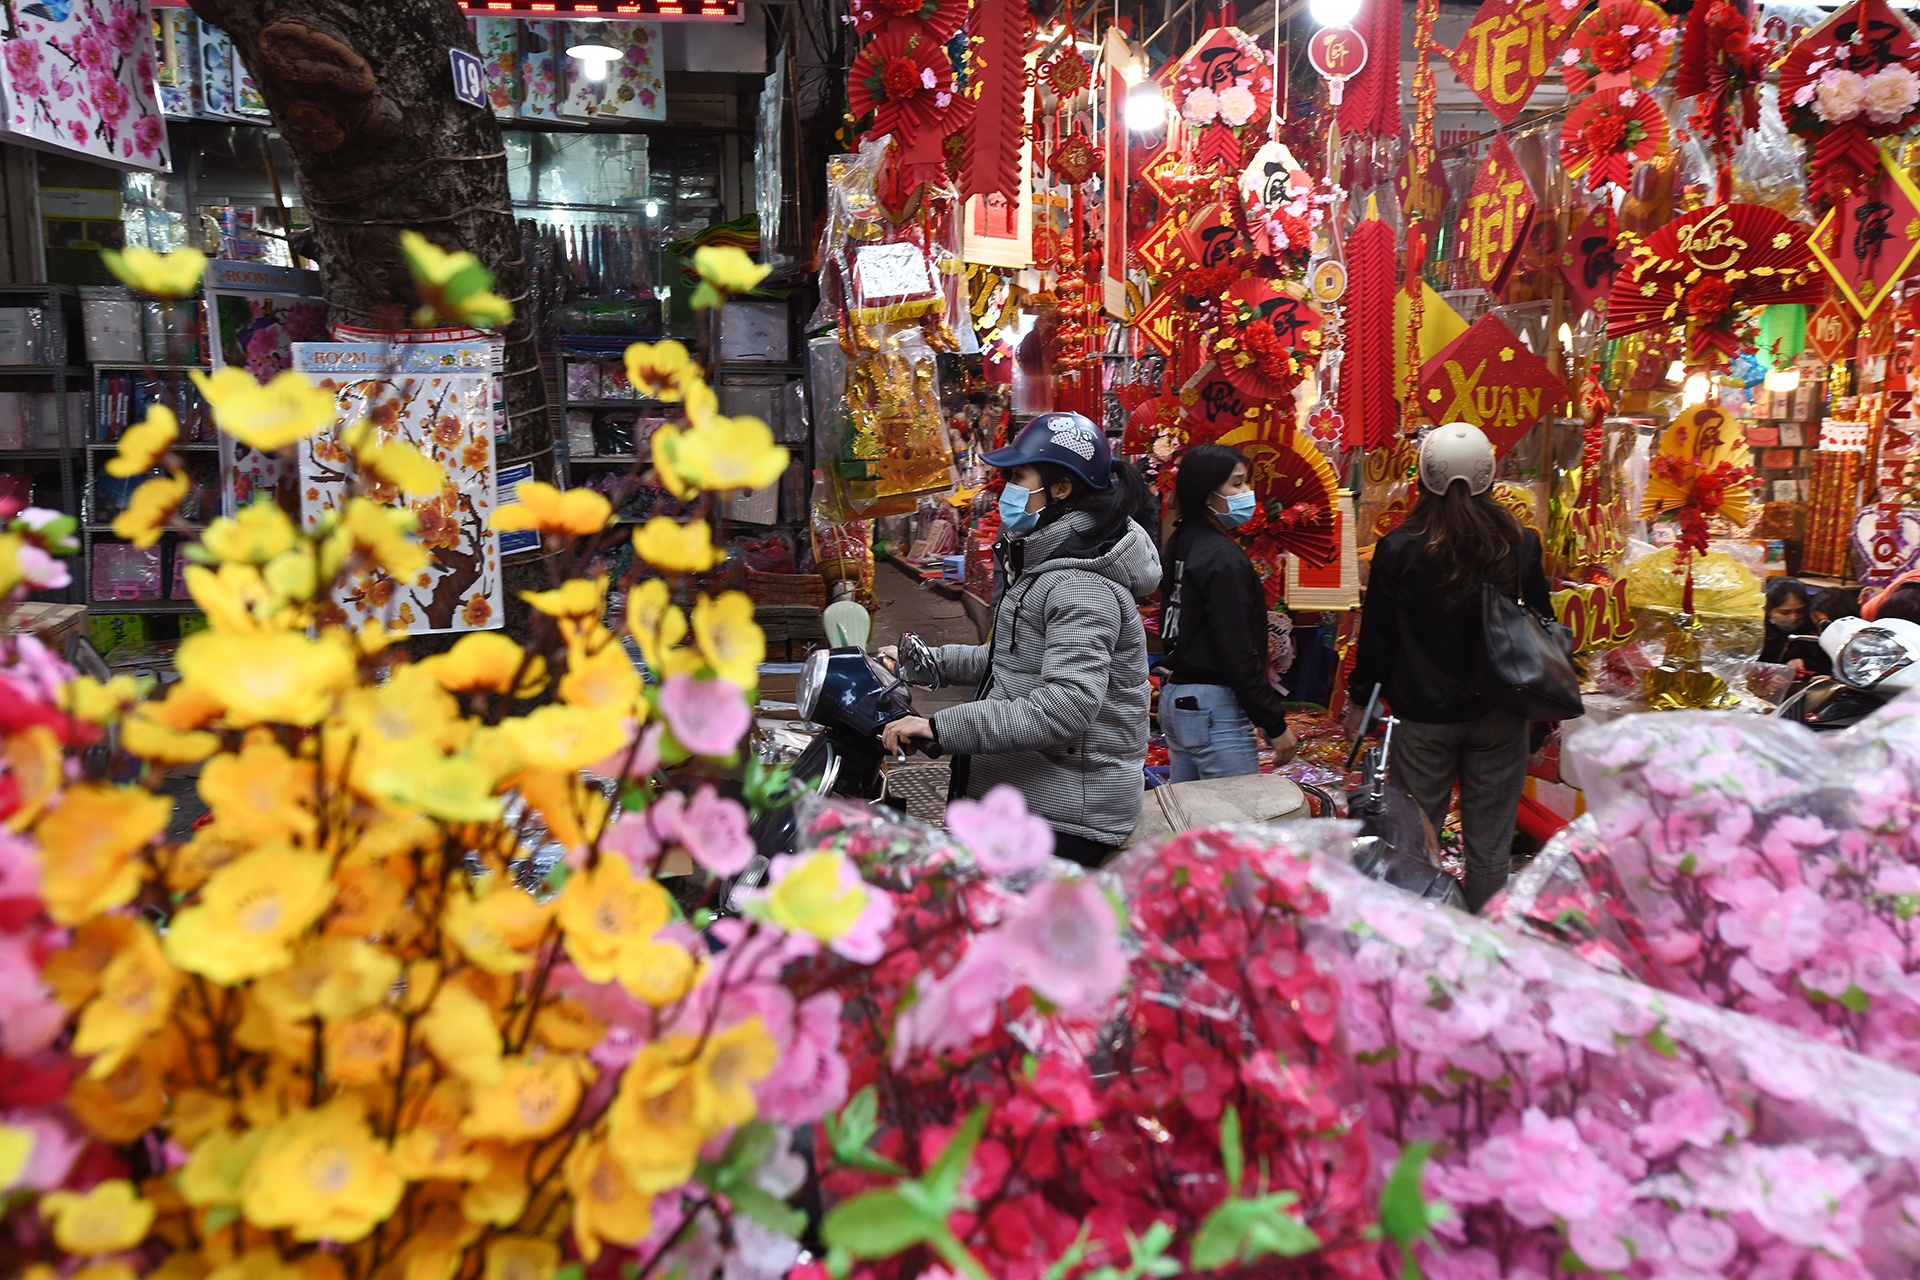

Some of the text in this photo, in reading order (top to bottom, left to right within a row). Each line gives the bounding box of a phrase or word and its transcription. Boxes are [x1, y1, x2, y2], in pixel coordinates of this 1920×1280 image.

[1468, 0, 1549, 104] TẾT
[459, 59, 480, 98] 19
[1067, 147, 1087, 167] 福
[1467, 168, 1525, 281] TẾT
[224, 269, 269, 284] ROOM
[313, 351, 367, 364] ROOM
[1563, 577, 1637, 654] 021
